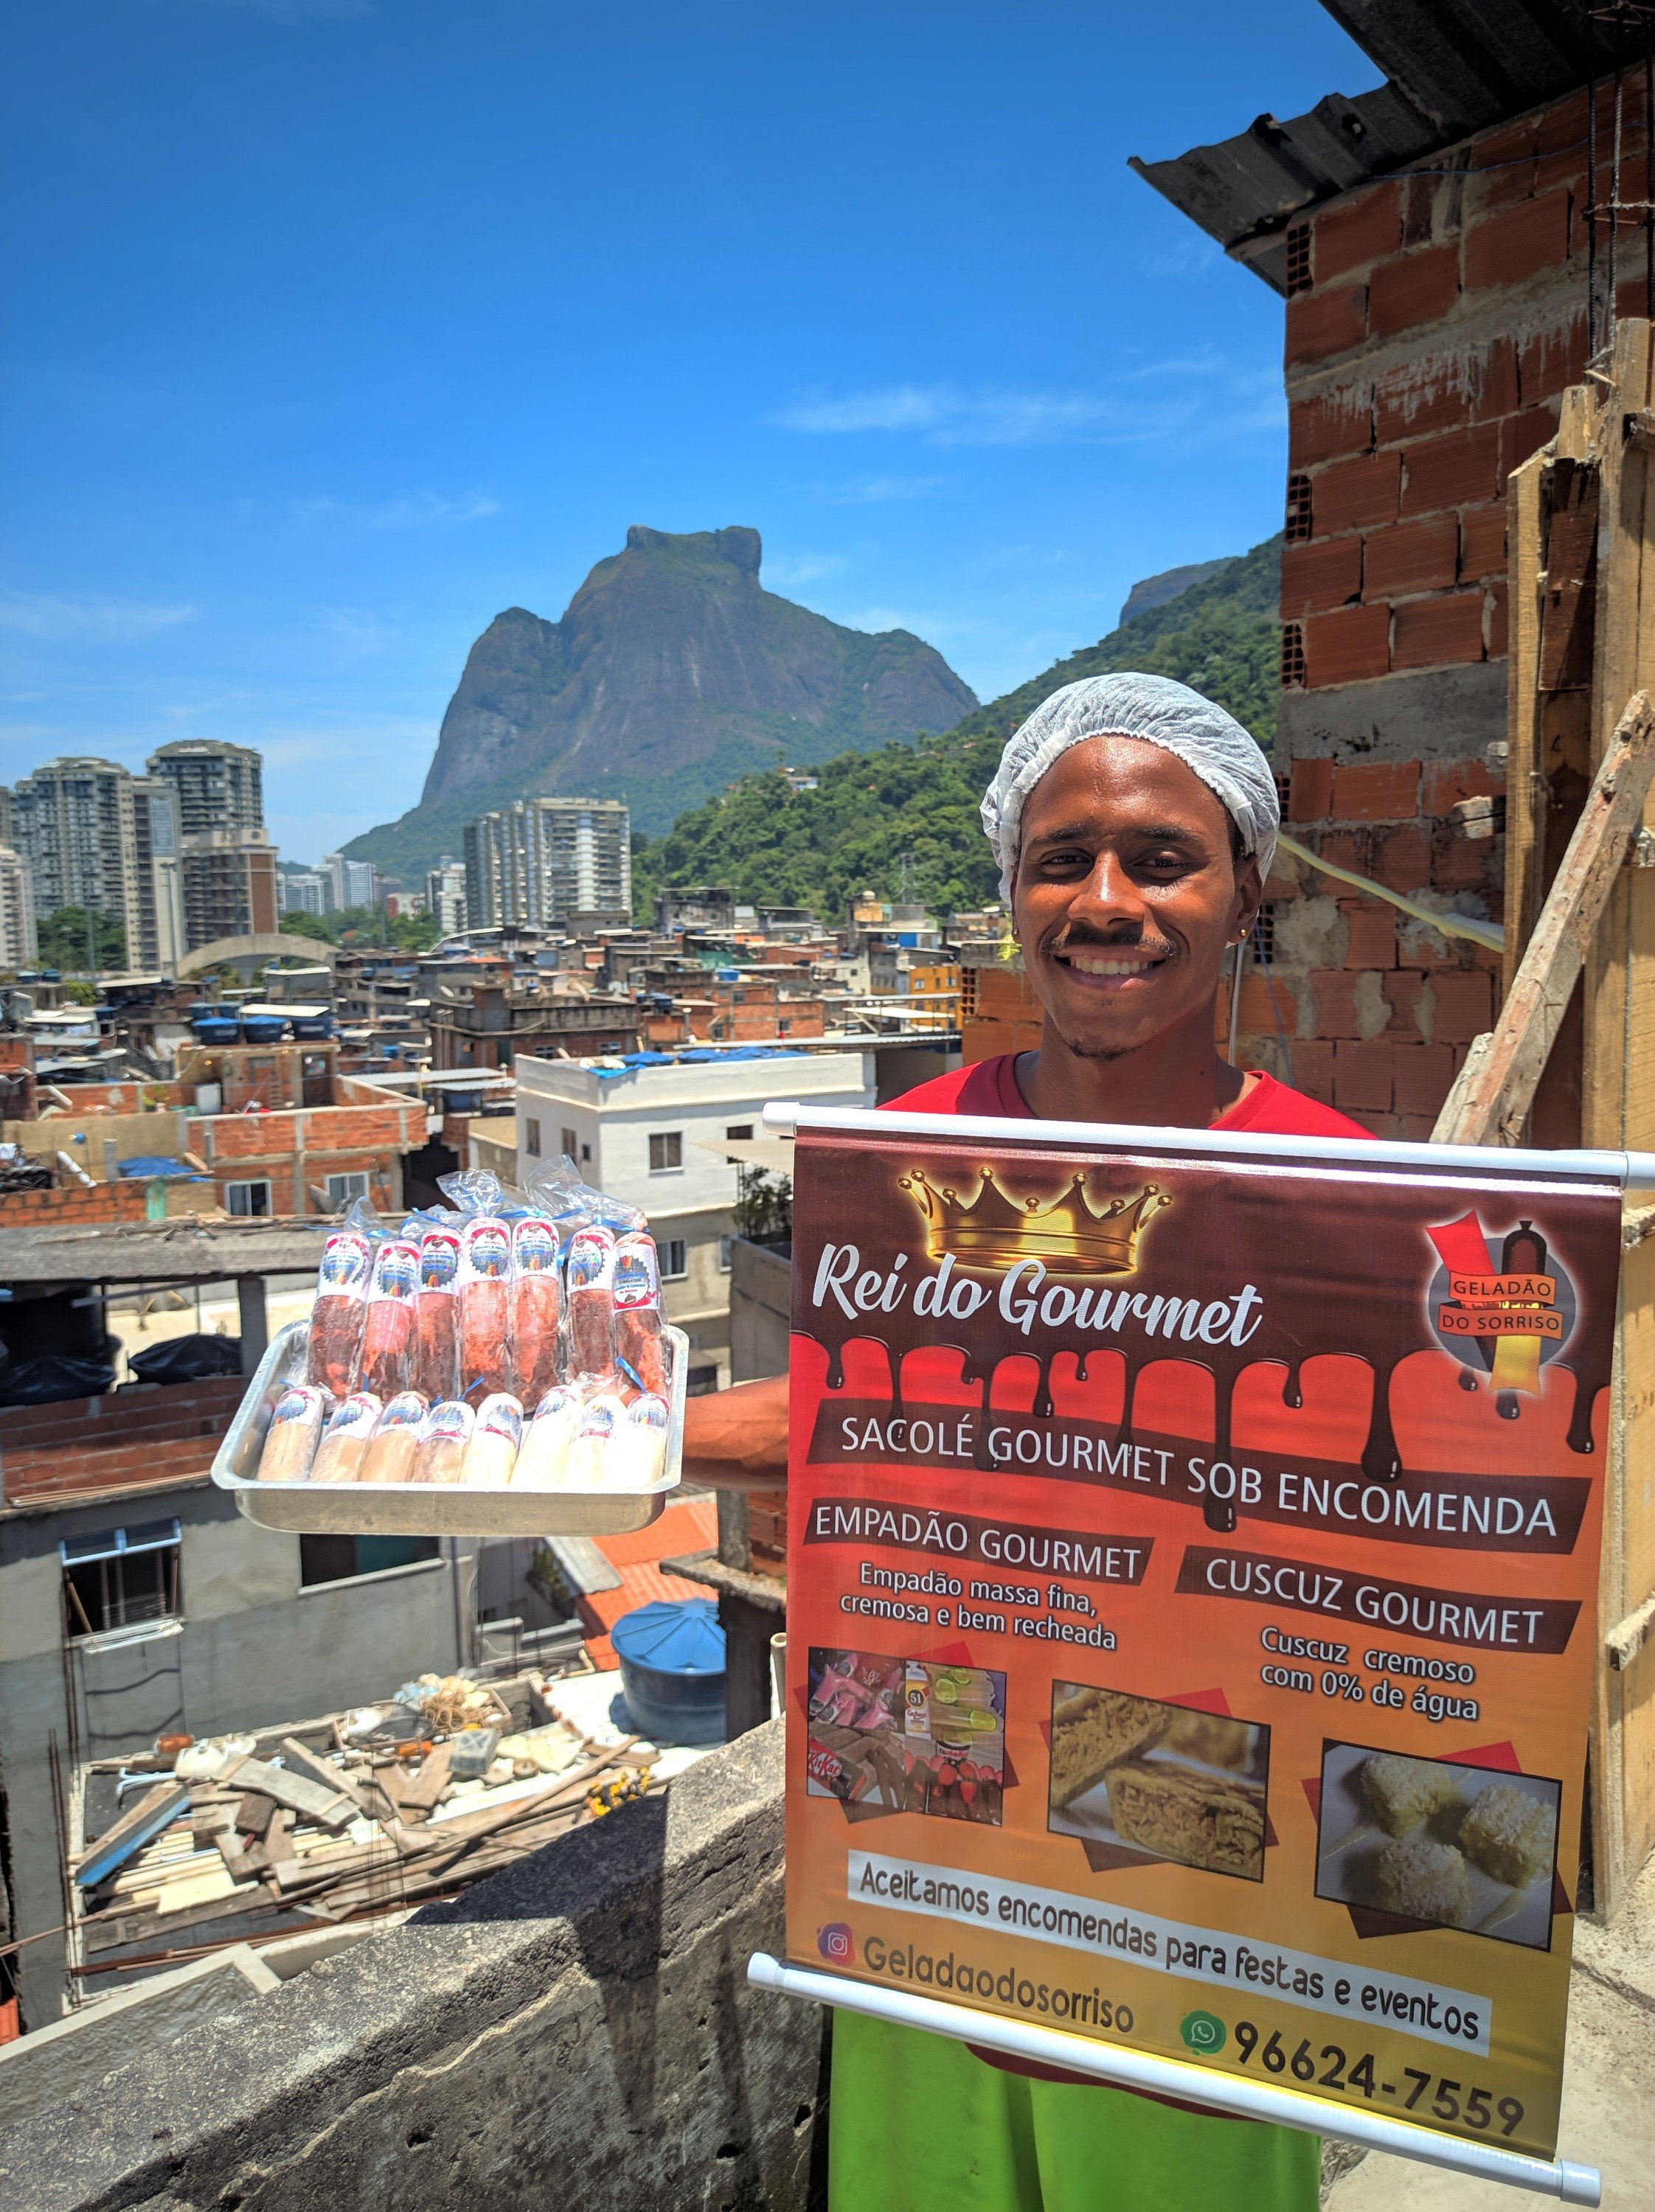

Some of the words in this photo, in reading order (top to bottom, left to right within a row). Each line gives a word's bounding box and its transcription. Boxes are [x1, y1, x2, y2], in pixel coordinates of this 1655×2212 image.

[812, 1244, 907, 1320] Rei
[913, 1253, 992, 1319] do
[999, 1259, 1263, 1346] Gourmet
[1454, 1279, 1550, 1296] GELADÃO
[1443, 1315, 1469, 1329] DO
[1477, 1316, 1559, 1330] SORRISO
[842, 1414, 974, 1458] SACOLÉ
[988, 1427, 1174, 1486] GOURMET
[1187, 1457, 1262, 1504] SOB
[1278, 1474, 1557, 1537] ENCOMENDA
[816, 1506, 968, 1551] EMPADÃO
[980, 1529, 1142, 1579] GOURMET
[860, 1563, 961, 1596] Empadão
[971, 1581, 1039, 1606] massa
[1048, 1585, 1097, 1616] fina,
[1206, 1558, 1343, 1611] CUSCUZ
[1355, 1586, 1544, 1644] GOURMET
[841, 1594, 929, 1624] cremosa
[937, 1607, 950, 1625] e
[958, 1604, 1005, 1632] bem
[1014, 1616, 1117, 1650] recheada
[1260, 1627, 1347, 1664] Cuscuz
[1364, 1647, 1474, 1683] cremoso
[909, 1692, 921, 1703] 51
[1260, 1664, 1312, 1691] com
[1322, 1671, 1363, 1700] 0%
[1372, 1680, 1403, 1708] de
[1412, 1686, 1478, 1720] água
[861, 1862, 989, 1915] Aceitamos
[999, 1896, 1157, 1956] encomendas
[1167, 1936, 1226, 1975] para
[1236, 1946, 1324, 1999] festas
[1334, 1978, 1351, 2005] e
[1361, 1984, 1479, 2040] eventos
[864, 1936, 1134, 2033] Geladaodosorriso
[1235, 2022, 1524, 2136] 96624-7559
